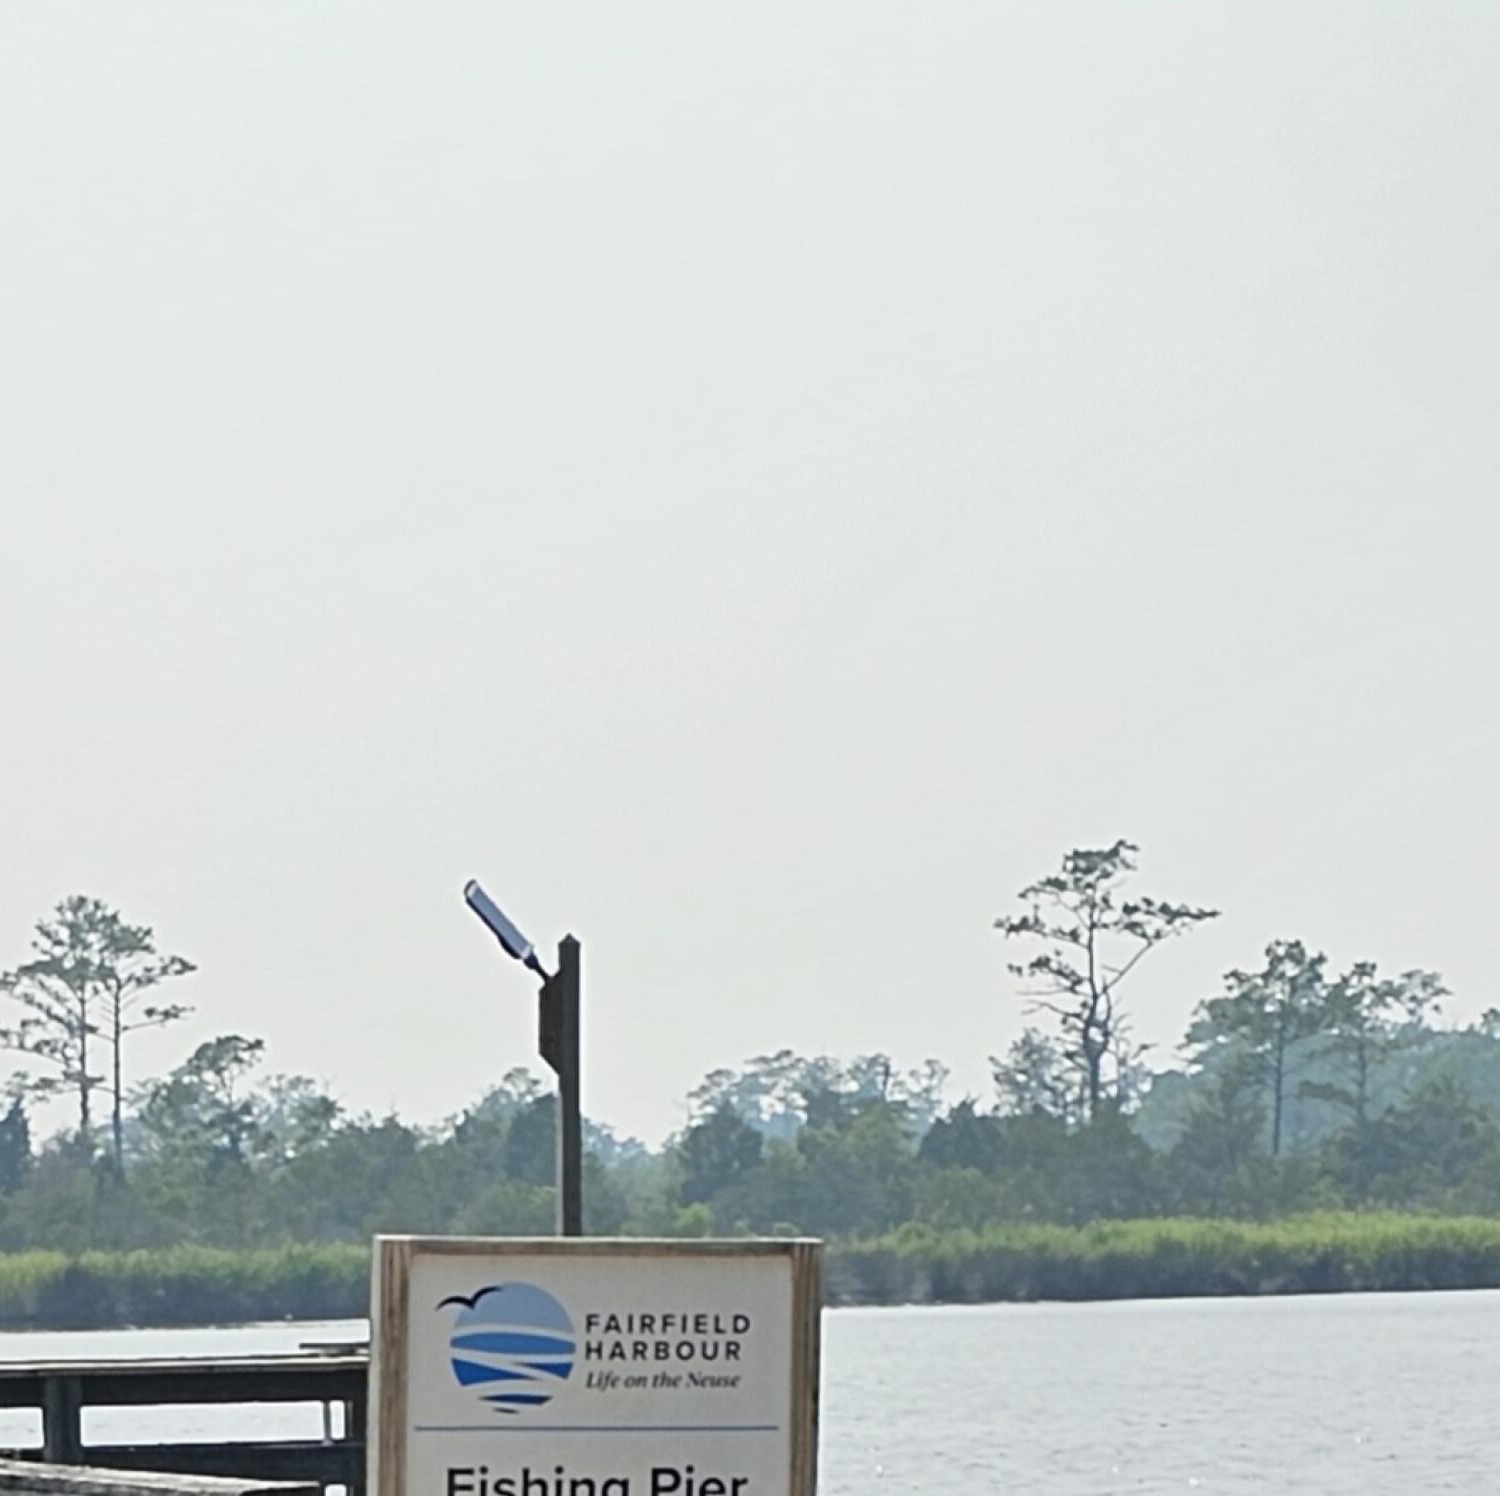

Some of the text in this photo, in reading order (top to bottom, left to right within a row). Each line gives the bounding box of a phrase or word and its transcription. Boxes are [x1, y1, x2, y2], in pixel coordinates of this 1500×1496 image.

[585, 1314, 751, 1334] FAIRFIELD
[585, 1341, 741, 1361] HARBOUR
[586, 1372, 741, 1391] Life on the Neuse
